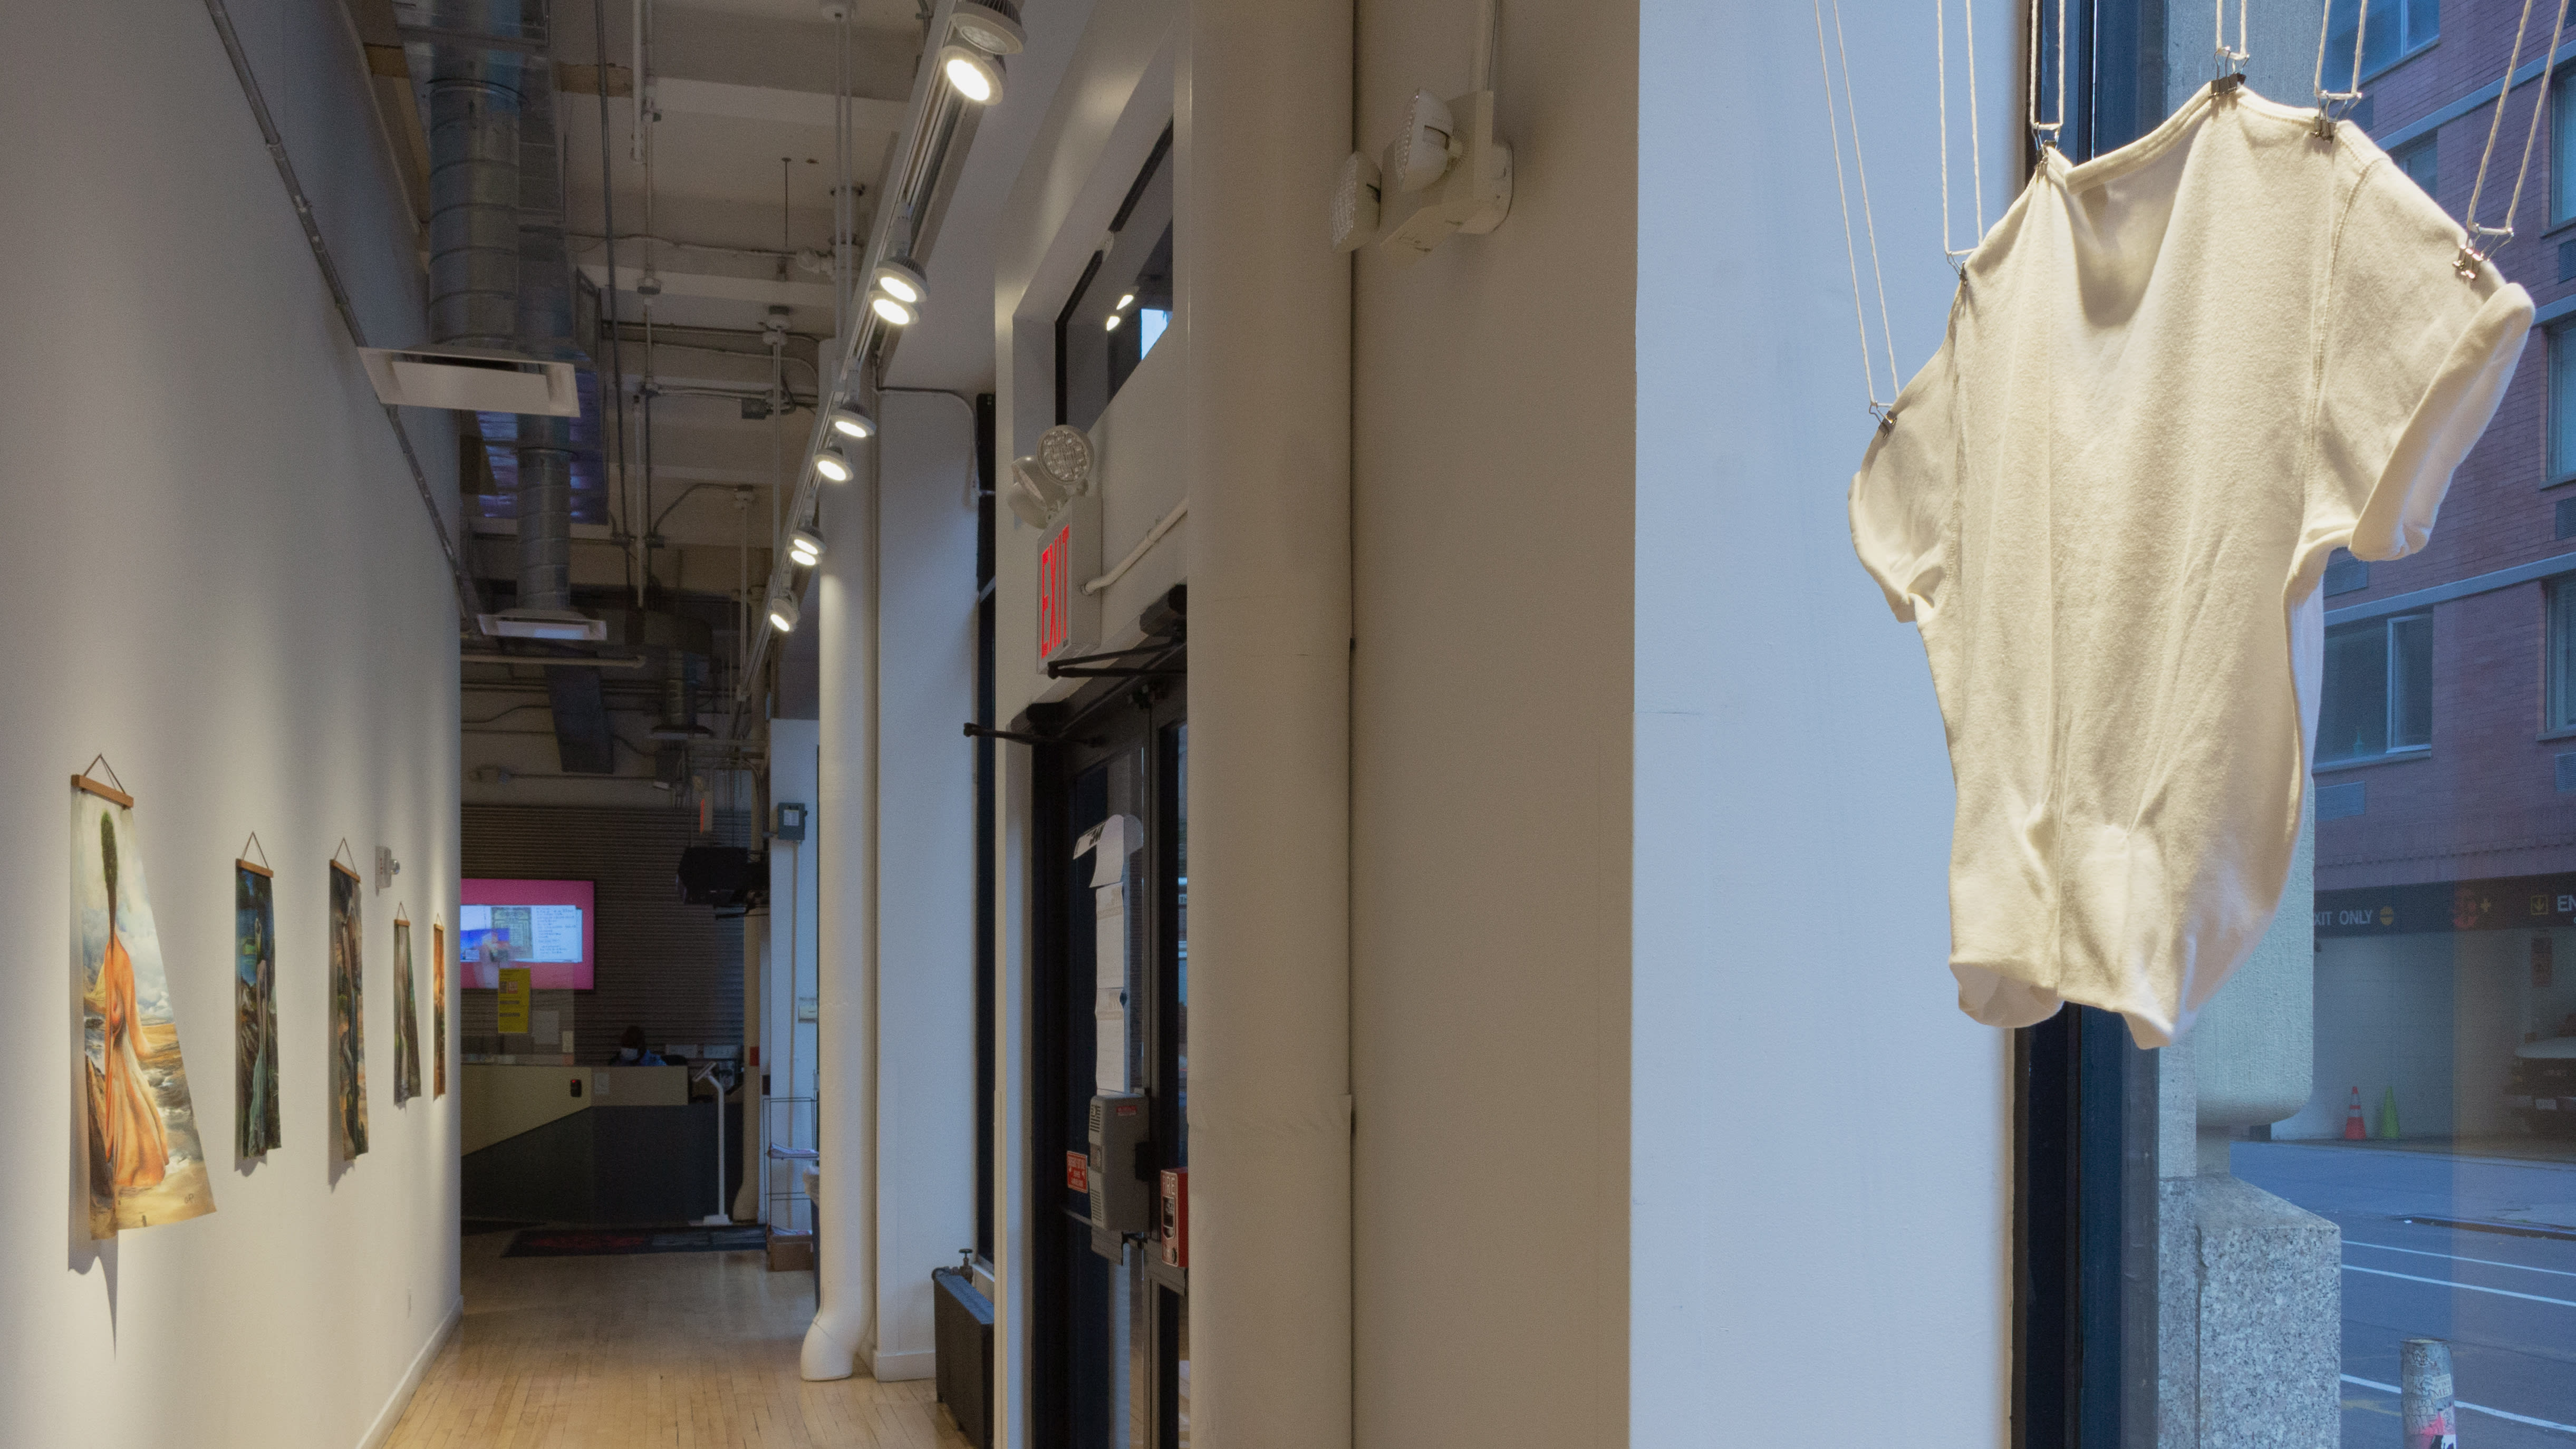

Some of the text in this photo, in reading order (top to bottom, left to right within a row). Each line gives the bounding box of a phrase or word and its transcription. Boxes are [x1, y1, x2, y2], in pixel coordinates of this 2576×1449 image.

[1041, 524, 1069, 659] EXIT
[2314, 910, 2372, 925] XIT ONLY
[1162, 1175, 1176, 1195] FIRE
[2434, 1385, 2452, 1398] MET
